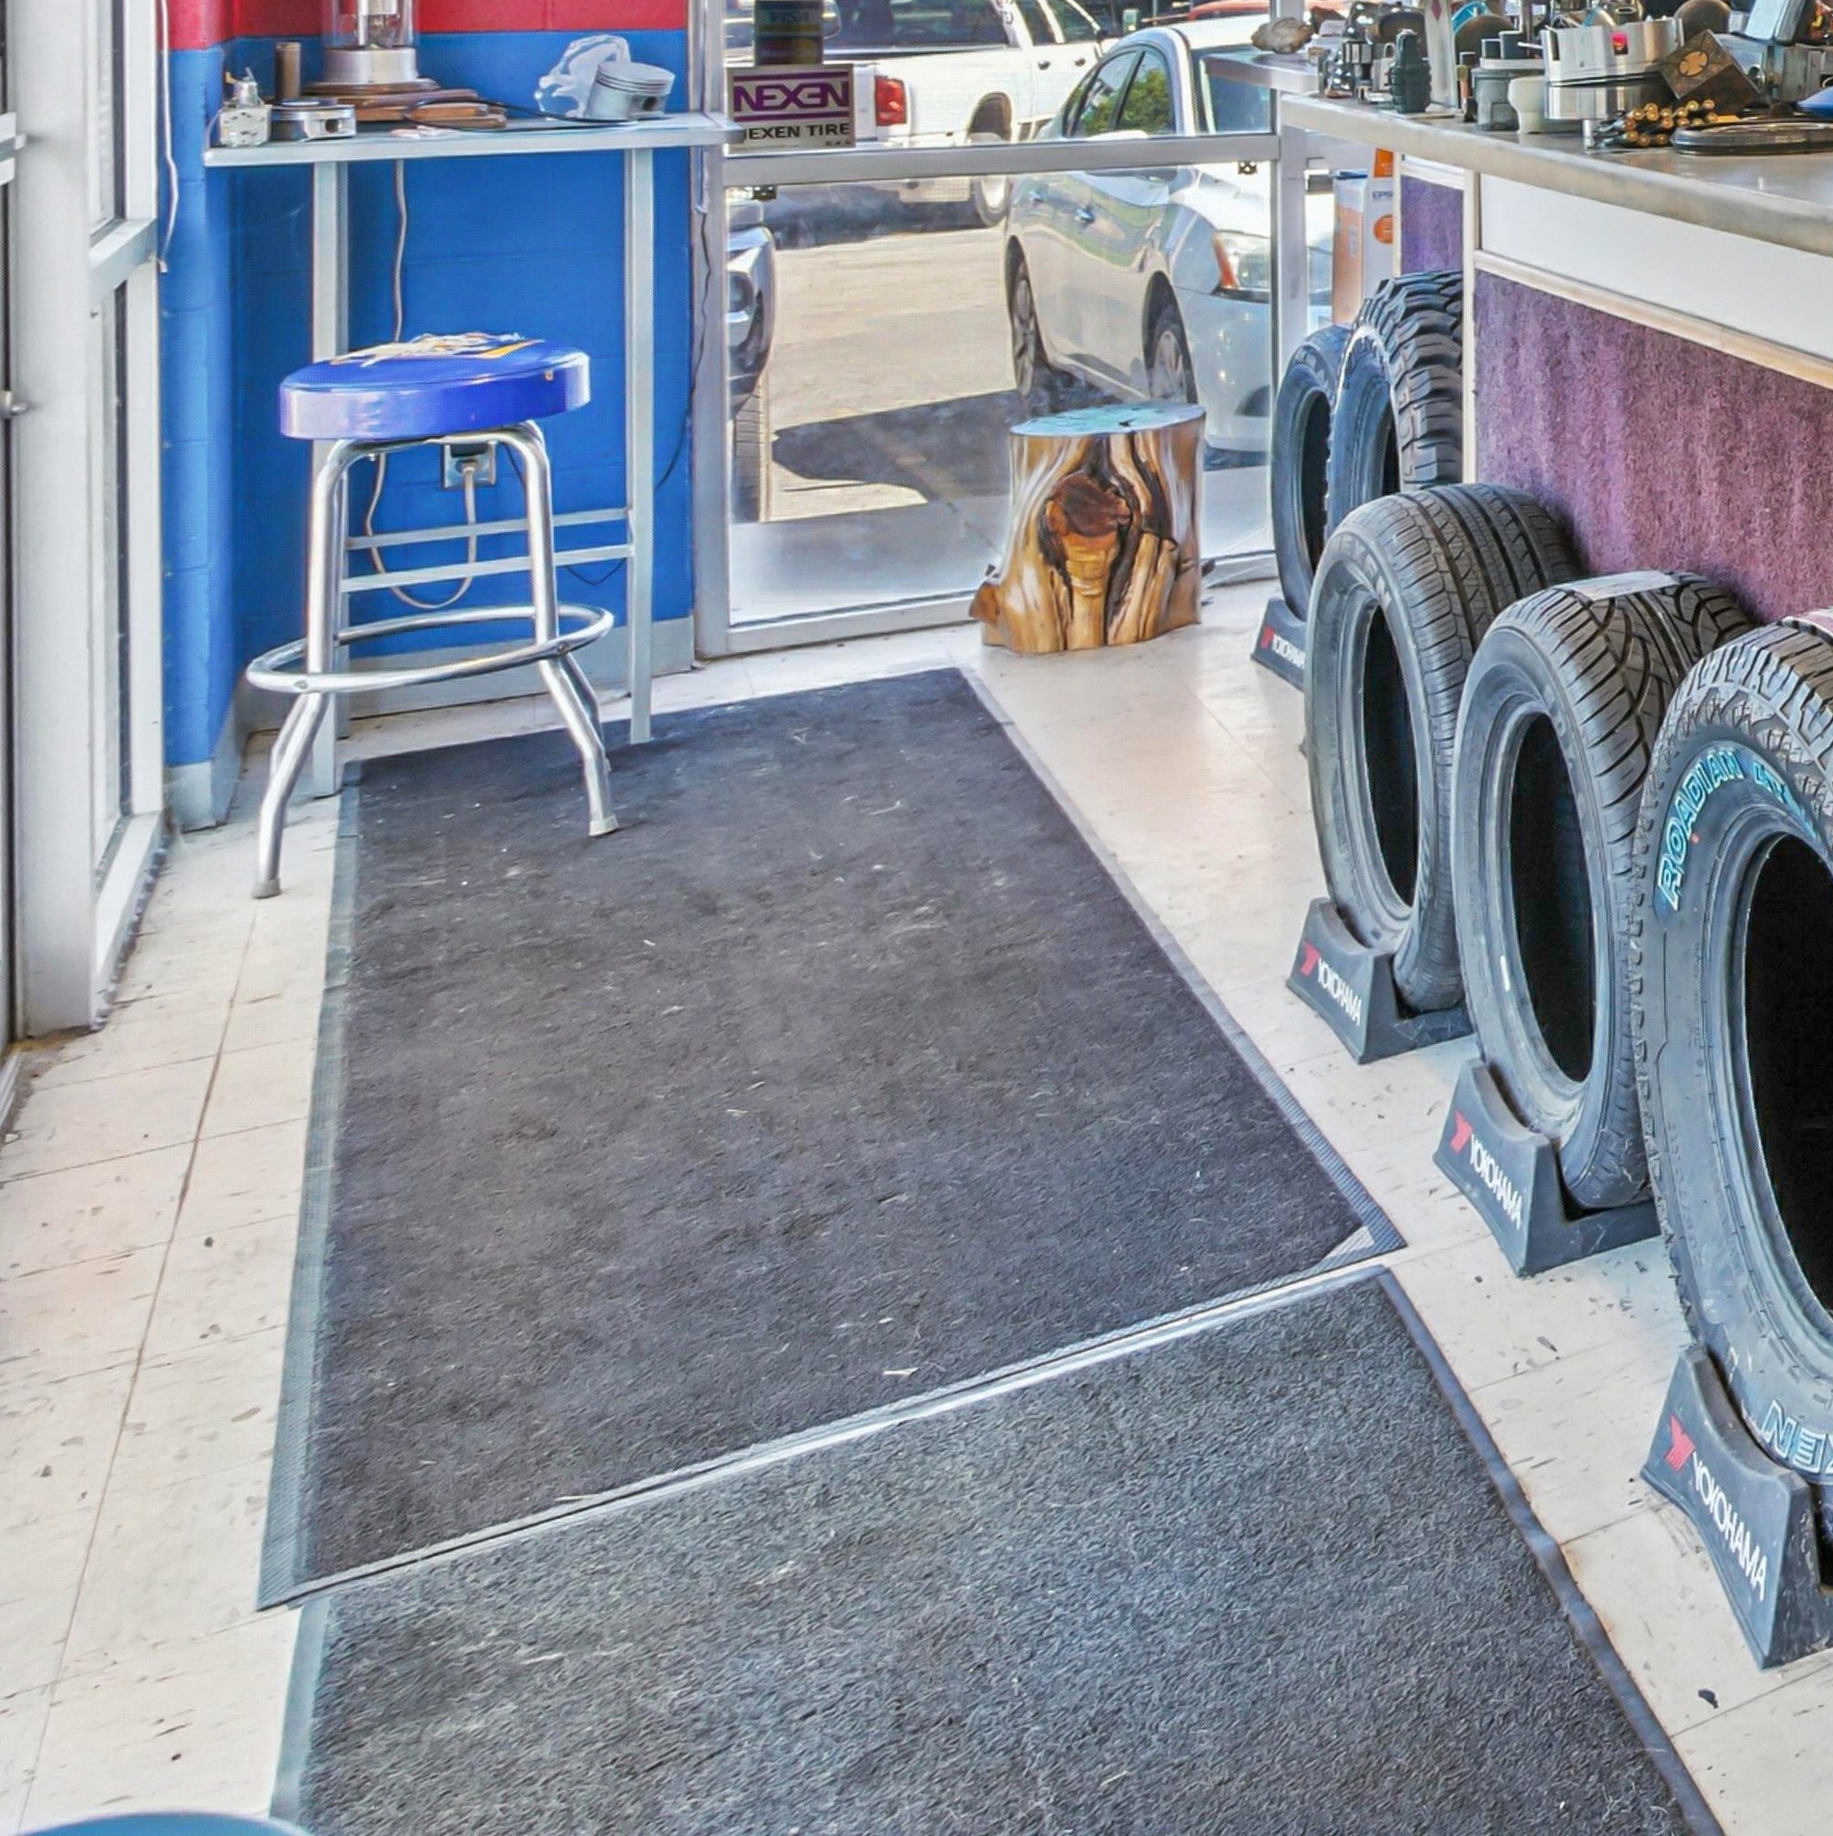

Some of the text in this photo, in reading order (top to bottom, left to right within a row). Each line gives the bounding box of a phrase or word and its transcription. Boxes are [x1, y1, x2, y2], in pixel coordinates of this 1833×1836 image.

[733, 81, 849, 112] NEXEN
[806, 122, 850, 137] TIRE
[1658, 748, 1745, 911] ROADIAN
[1317, 957, 1361, 1026] YOKOHAMA
[1468, 1133, 1524, 1230] YOKOHAMA
[1692, 1452, 1768, 1602] YOKOHAMA
